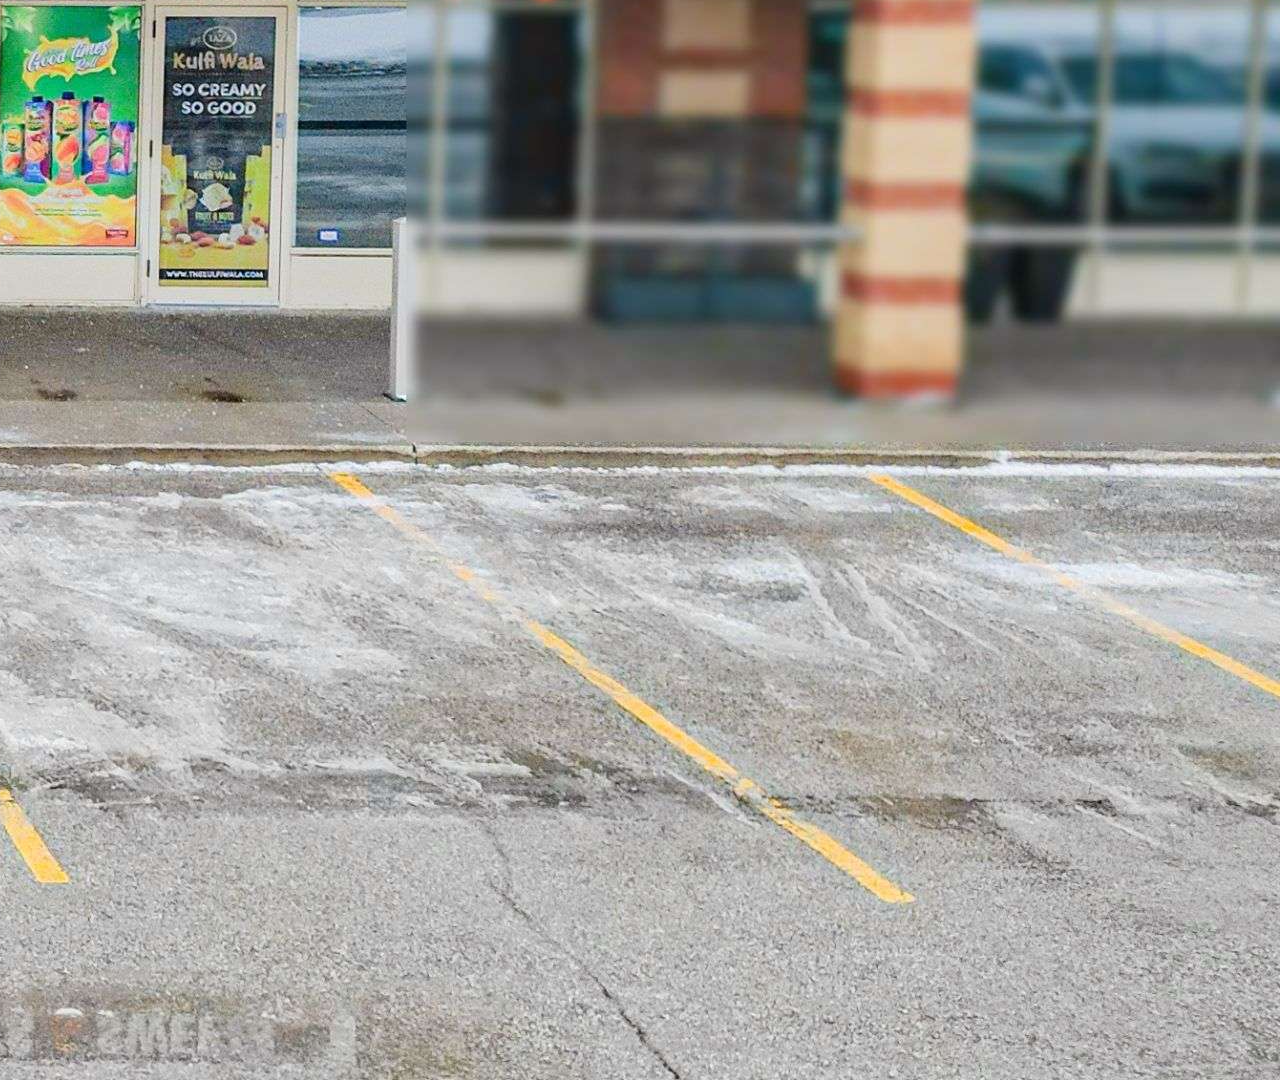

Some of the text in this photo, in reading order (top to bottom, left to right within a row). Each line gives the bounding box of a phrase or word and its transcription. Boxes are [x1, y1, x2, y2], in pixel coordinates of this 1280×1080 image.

[172, 50, 265, 71] Kulfi Wala
[172, 83, 267, 97] SO CREAMY
[181, 101, 257, 115] SO GOOD
